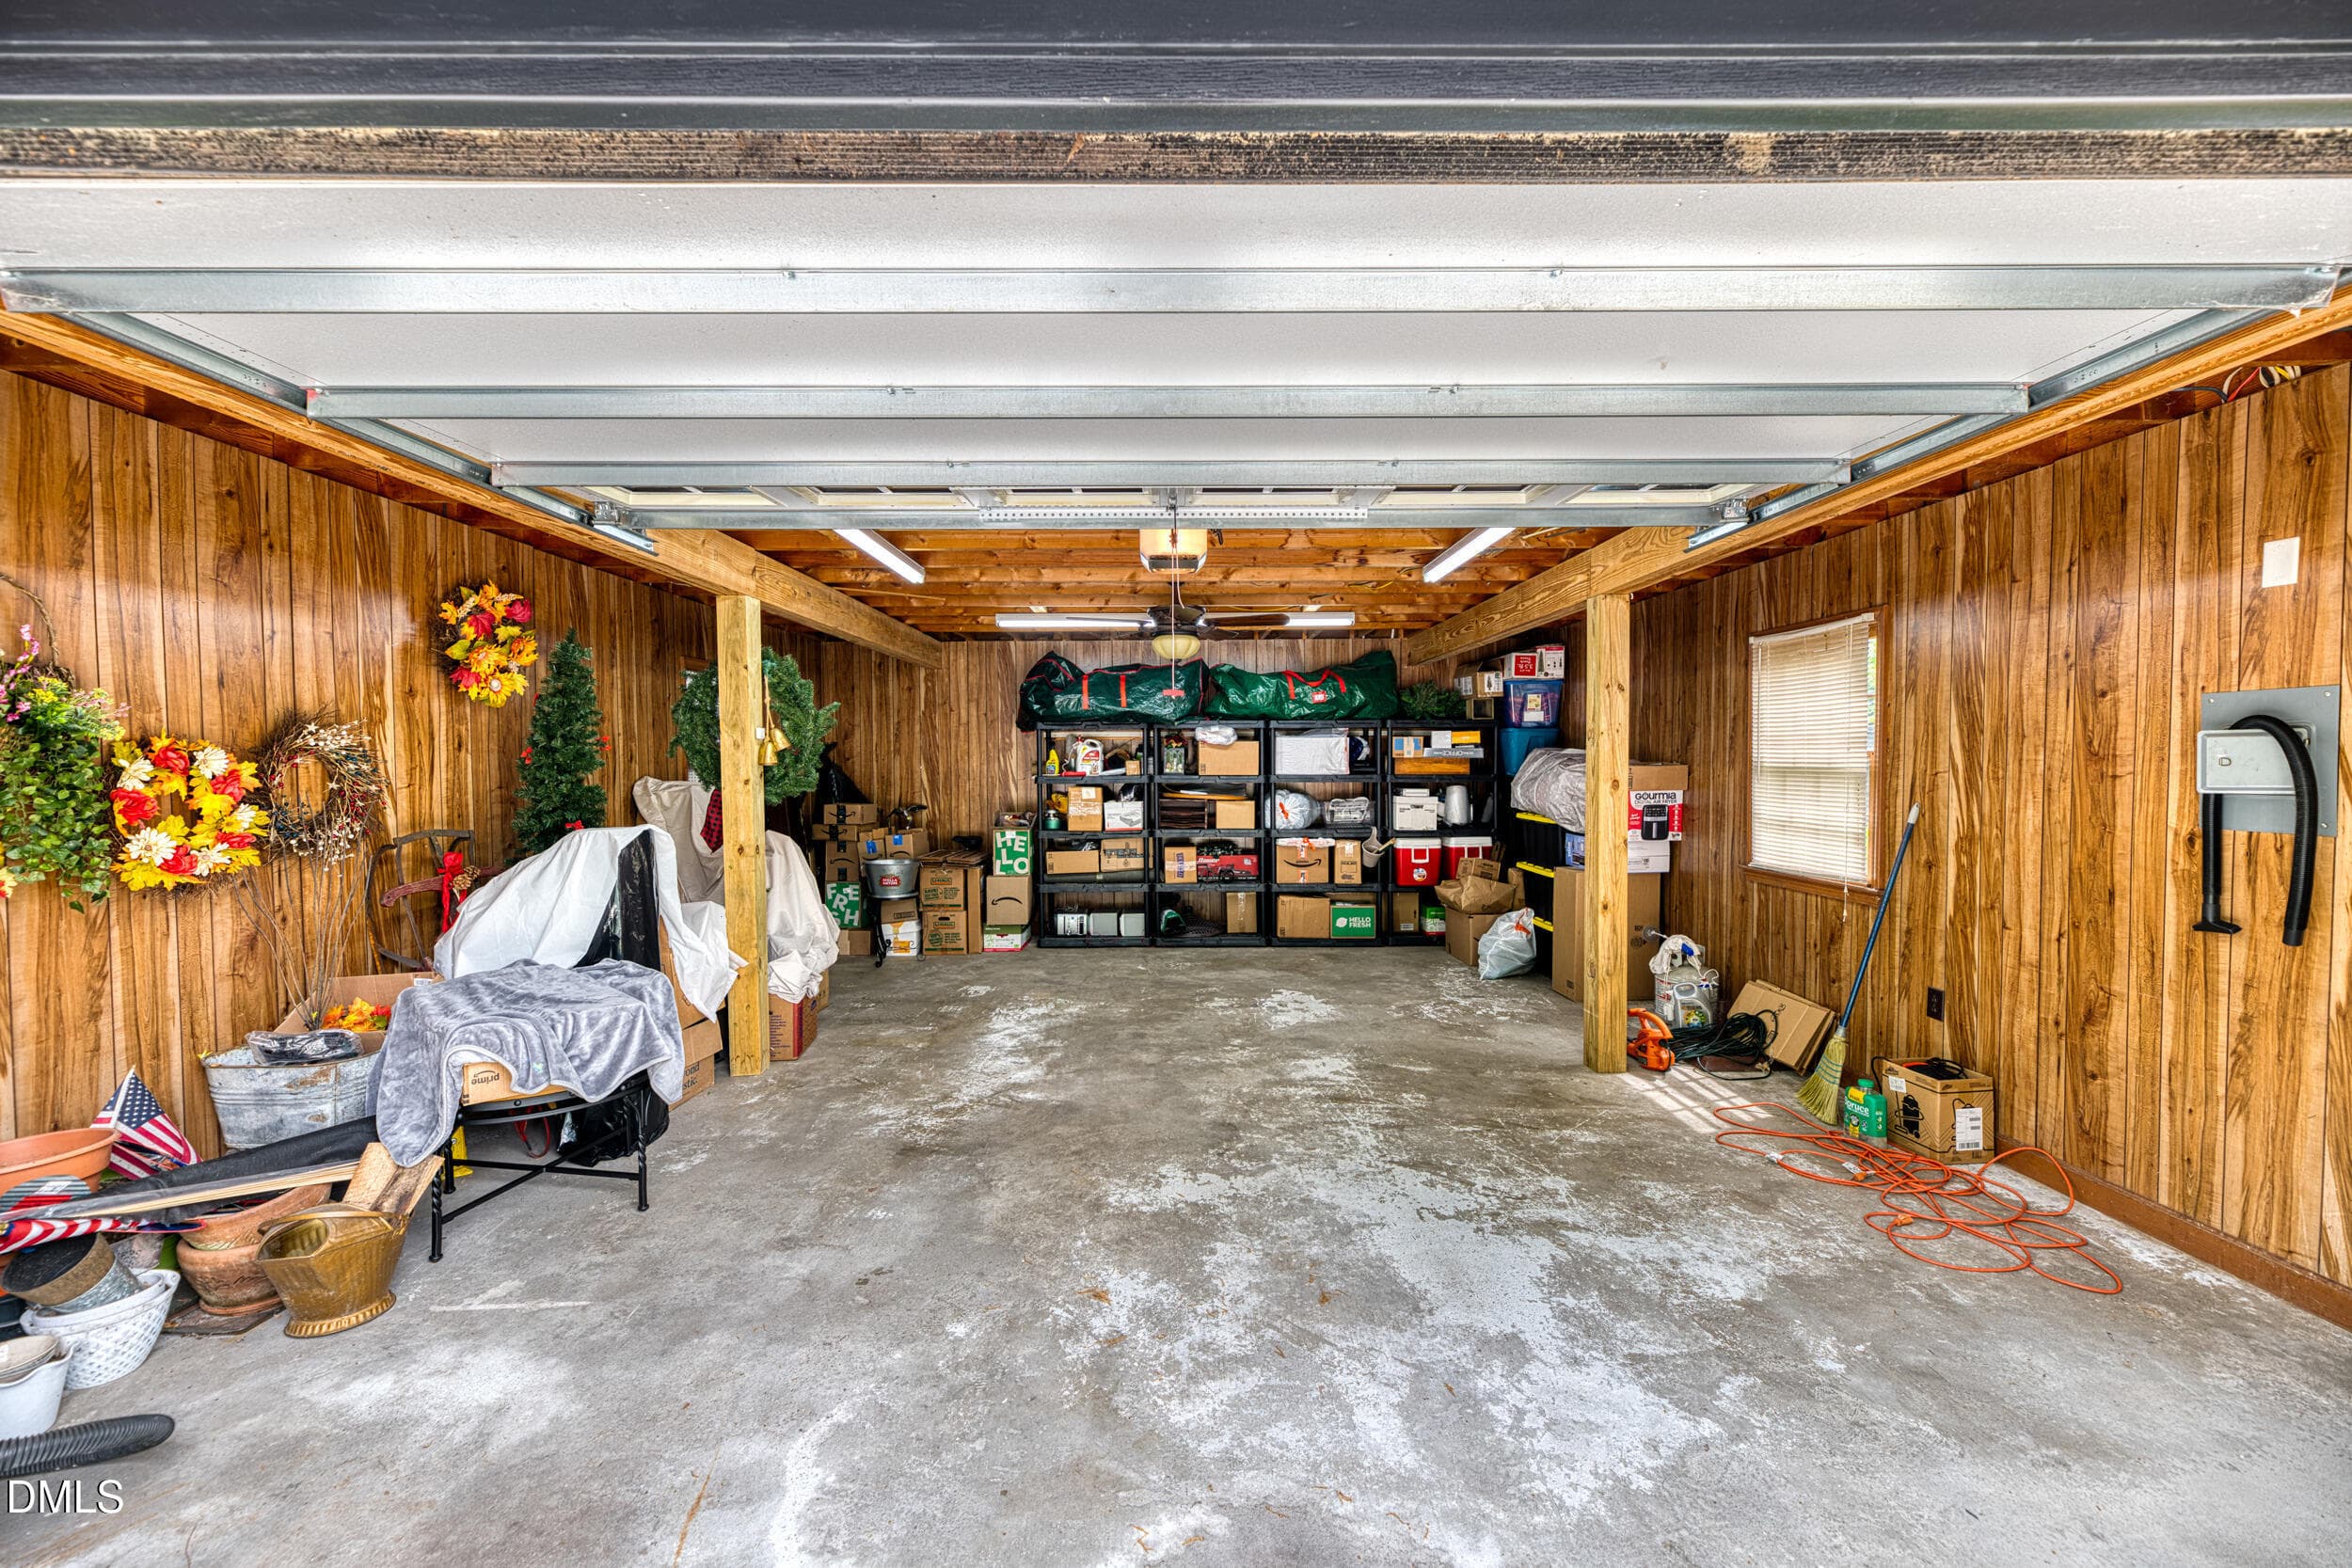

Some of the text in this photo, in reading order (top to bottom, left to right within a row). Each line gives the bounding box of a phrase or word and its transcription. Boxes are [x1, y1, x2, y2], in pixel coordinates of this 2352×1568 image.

[684, 1061, 700, 1077] ond
[471, 1072, 501, 1086] prime
[683, 1076, 698, 1089] stic.
